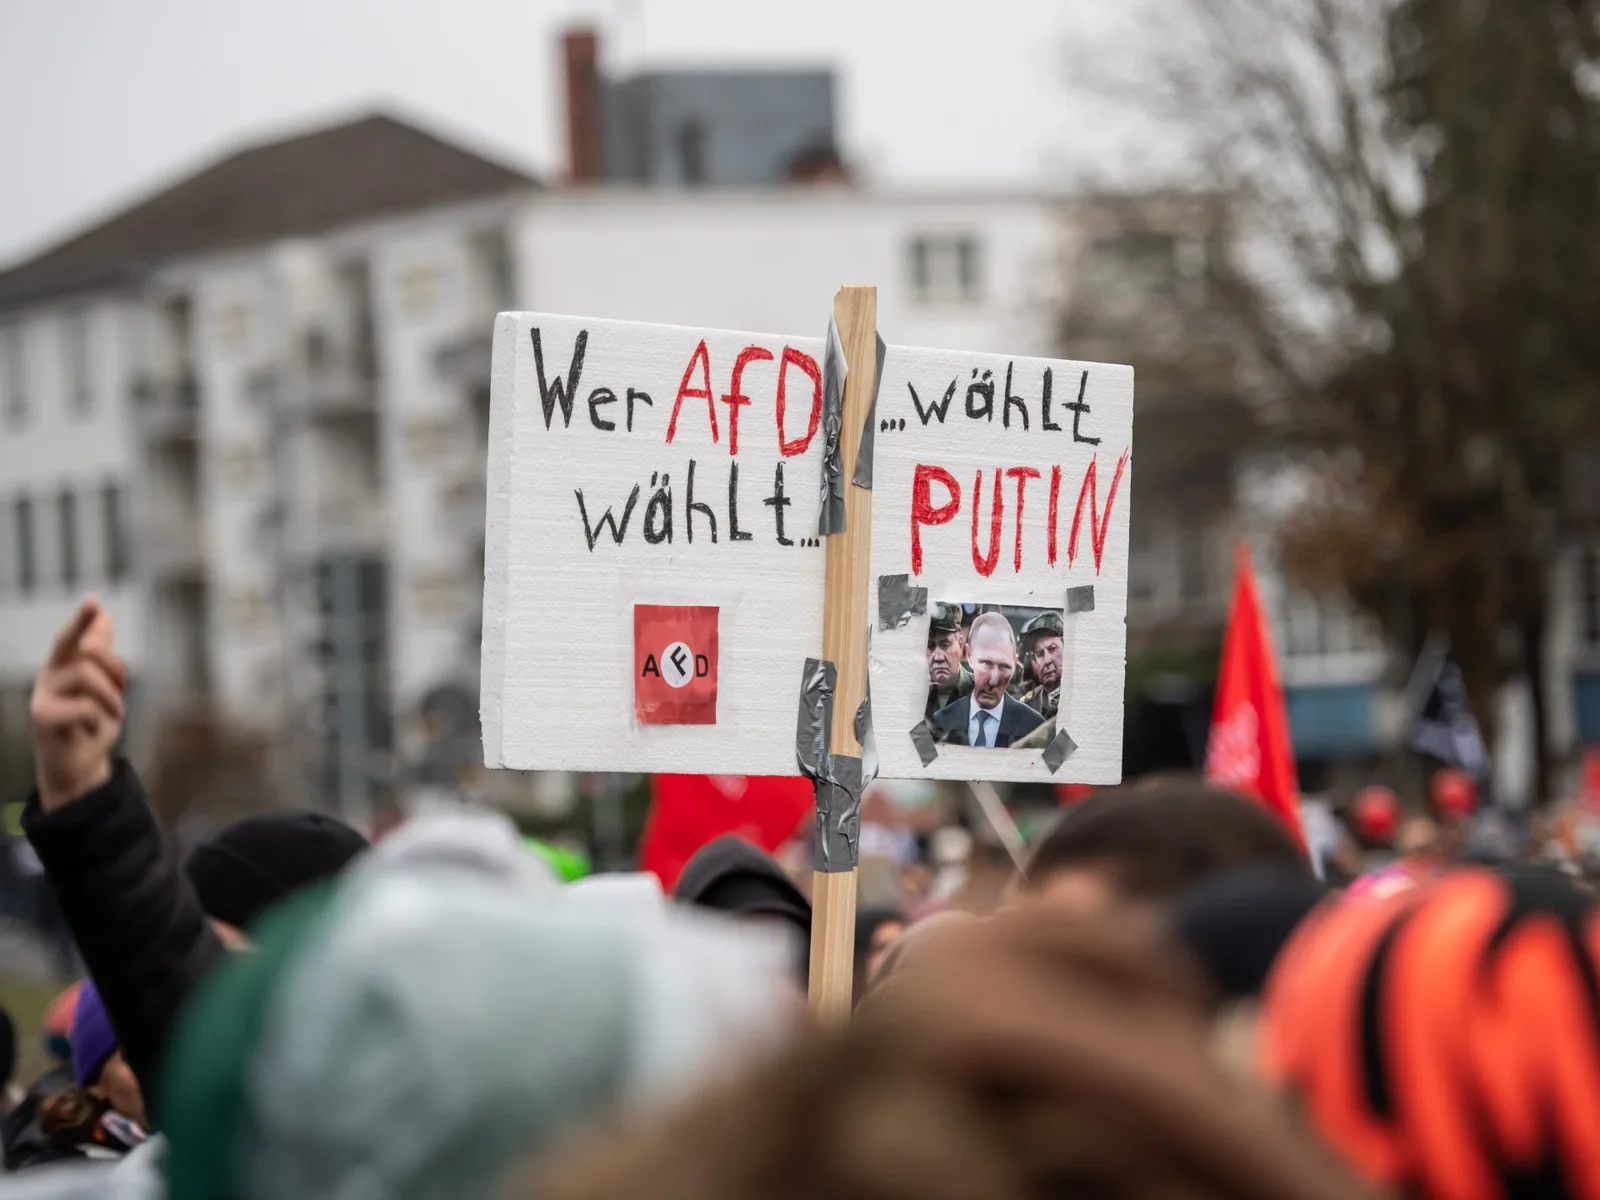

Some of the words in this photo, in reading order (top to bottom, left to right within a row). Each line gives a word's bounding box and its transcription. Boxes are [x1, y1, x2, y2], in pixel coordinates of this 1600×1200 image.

[530, 327, 653, 432] Wer
[665, 338, 823, 458] AfD
[911, 445, 1129, 578] PUTIN
